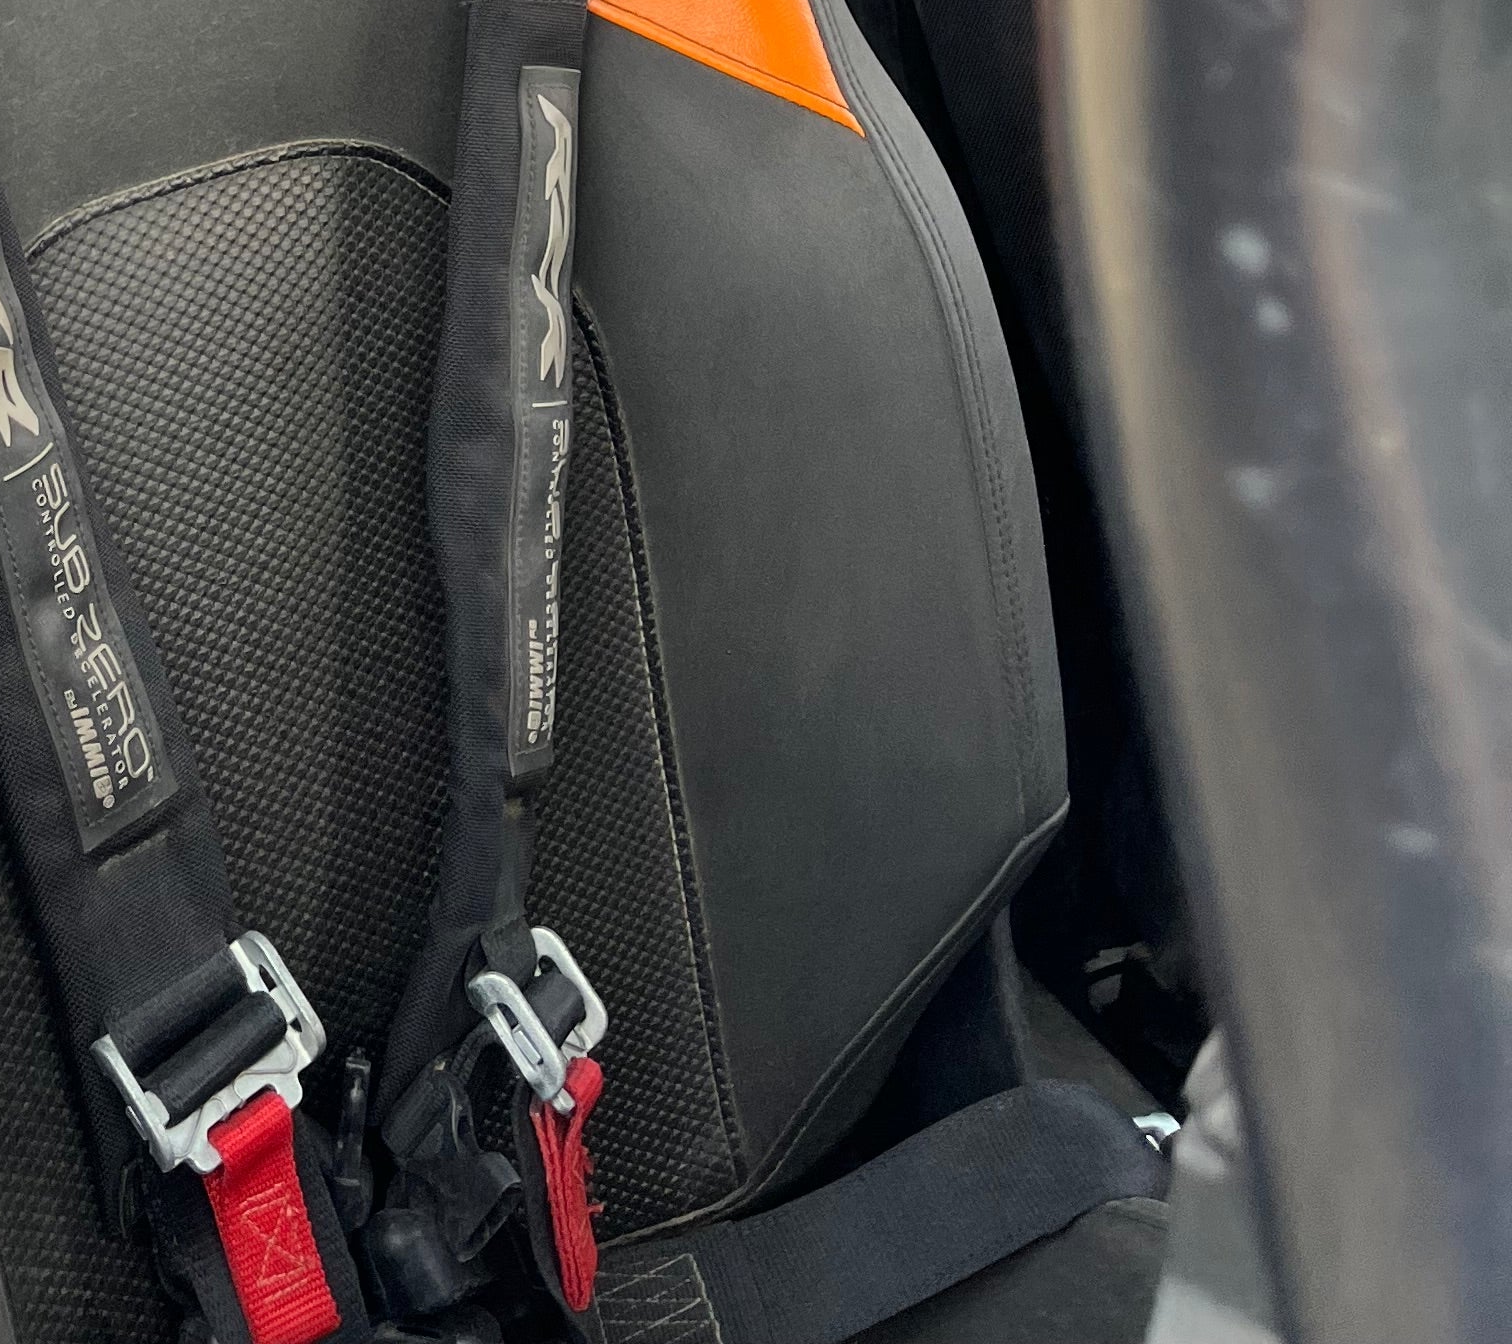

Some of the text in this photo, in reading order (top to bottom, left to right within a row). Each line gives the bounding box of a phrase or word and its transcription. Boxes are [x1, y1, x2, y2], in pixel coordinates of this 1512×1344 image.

[32, 478, 129, 790] CONTROLLED DECELERATOR
[42, 463, 150, 778] SUB ZERO
[70, 706, 109, 778] IMMI
